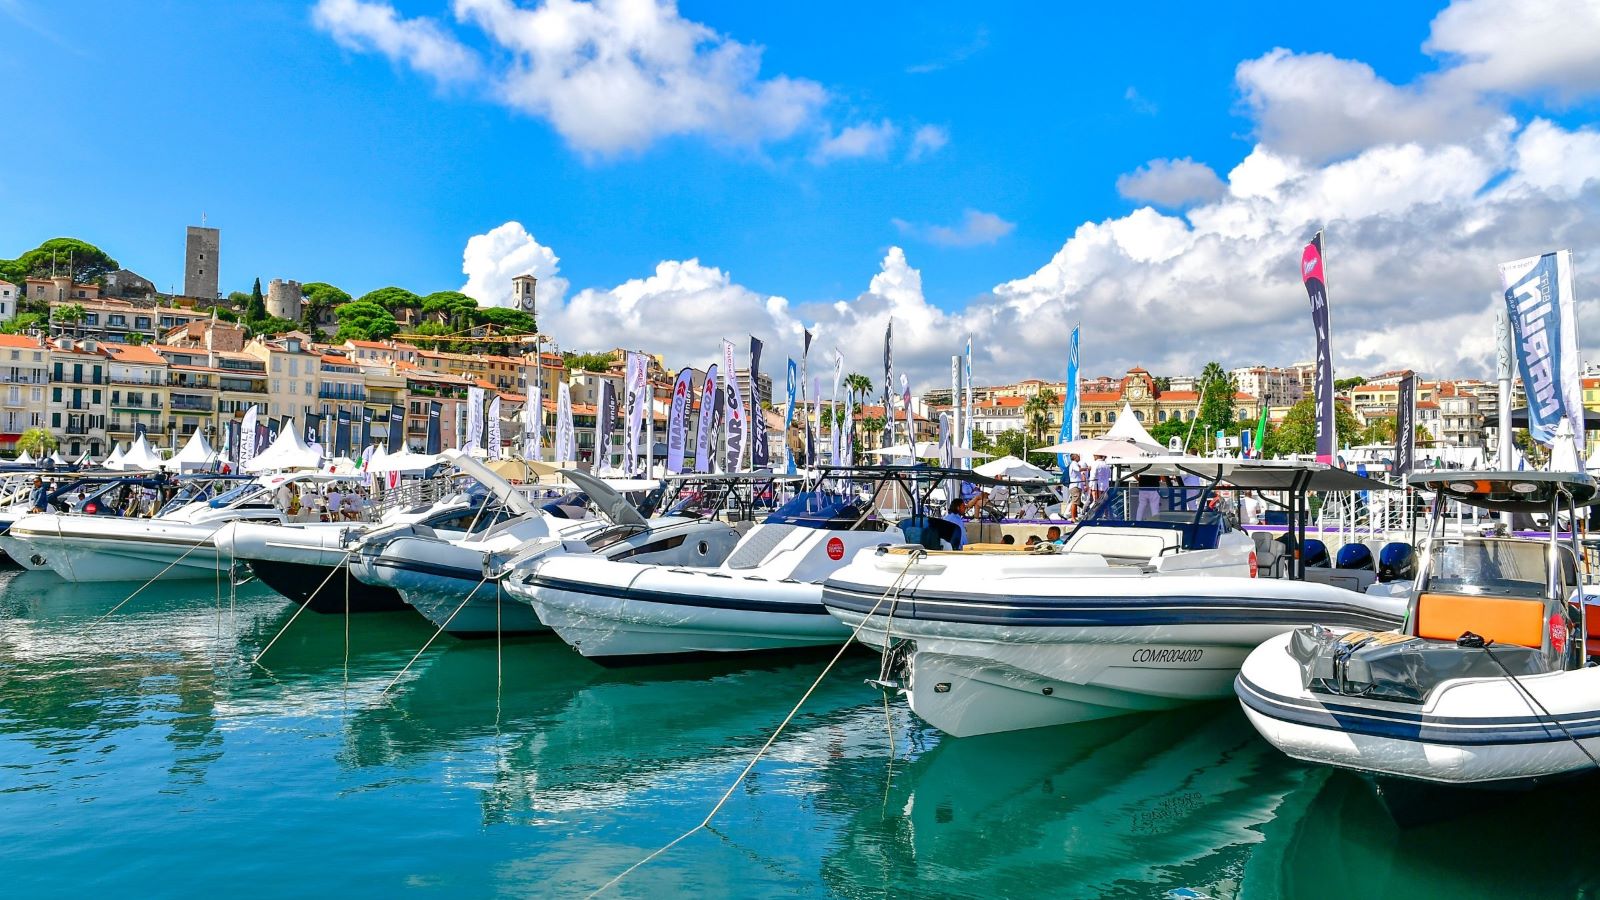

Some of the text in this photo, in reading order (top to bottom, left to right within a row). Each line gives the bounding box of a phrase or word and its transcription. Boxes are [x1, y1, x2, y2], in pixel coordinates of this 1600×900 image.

[1225, 438, 1231, 446] B
[240, 427, 249, 475] FANALE
[1132, 648, 1204, 663] COMR00400D
